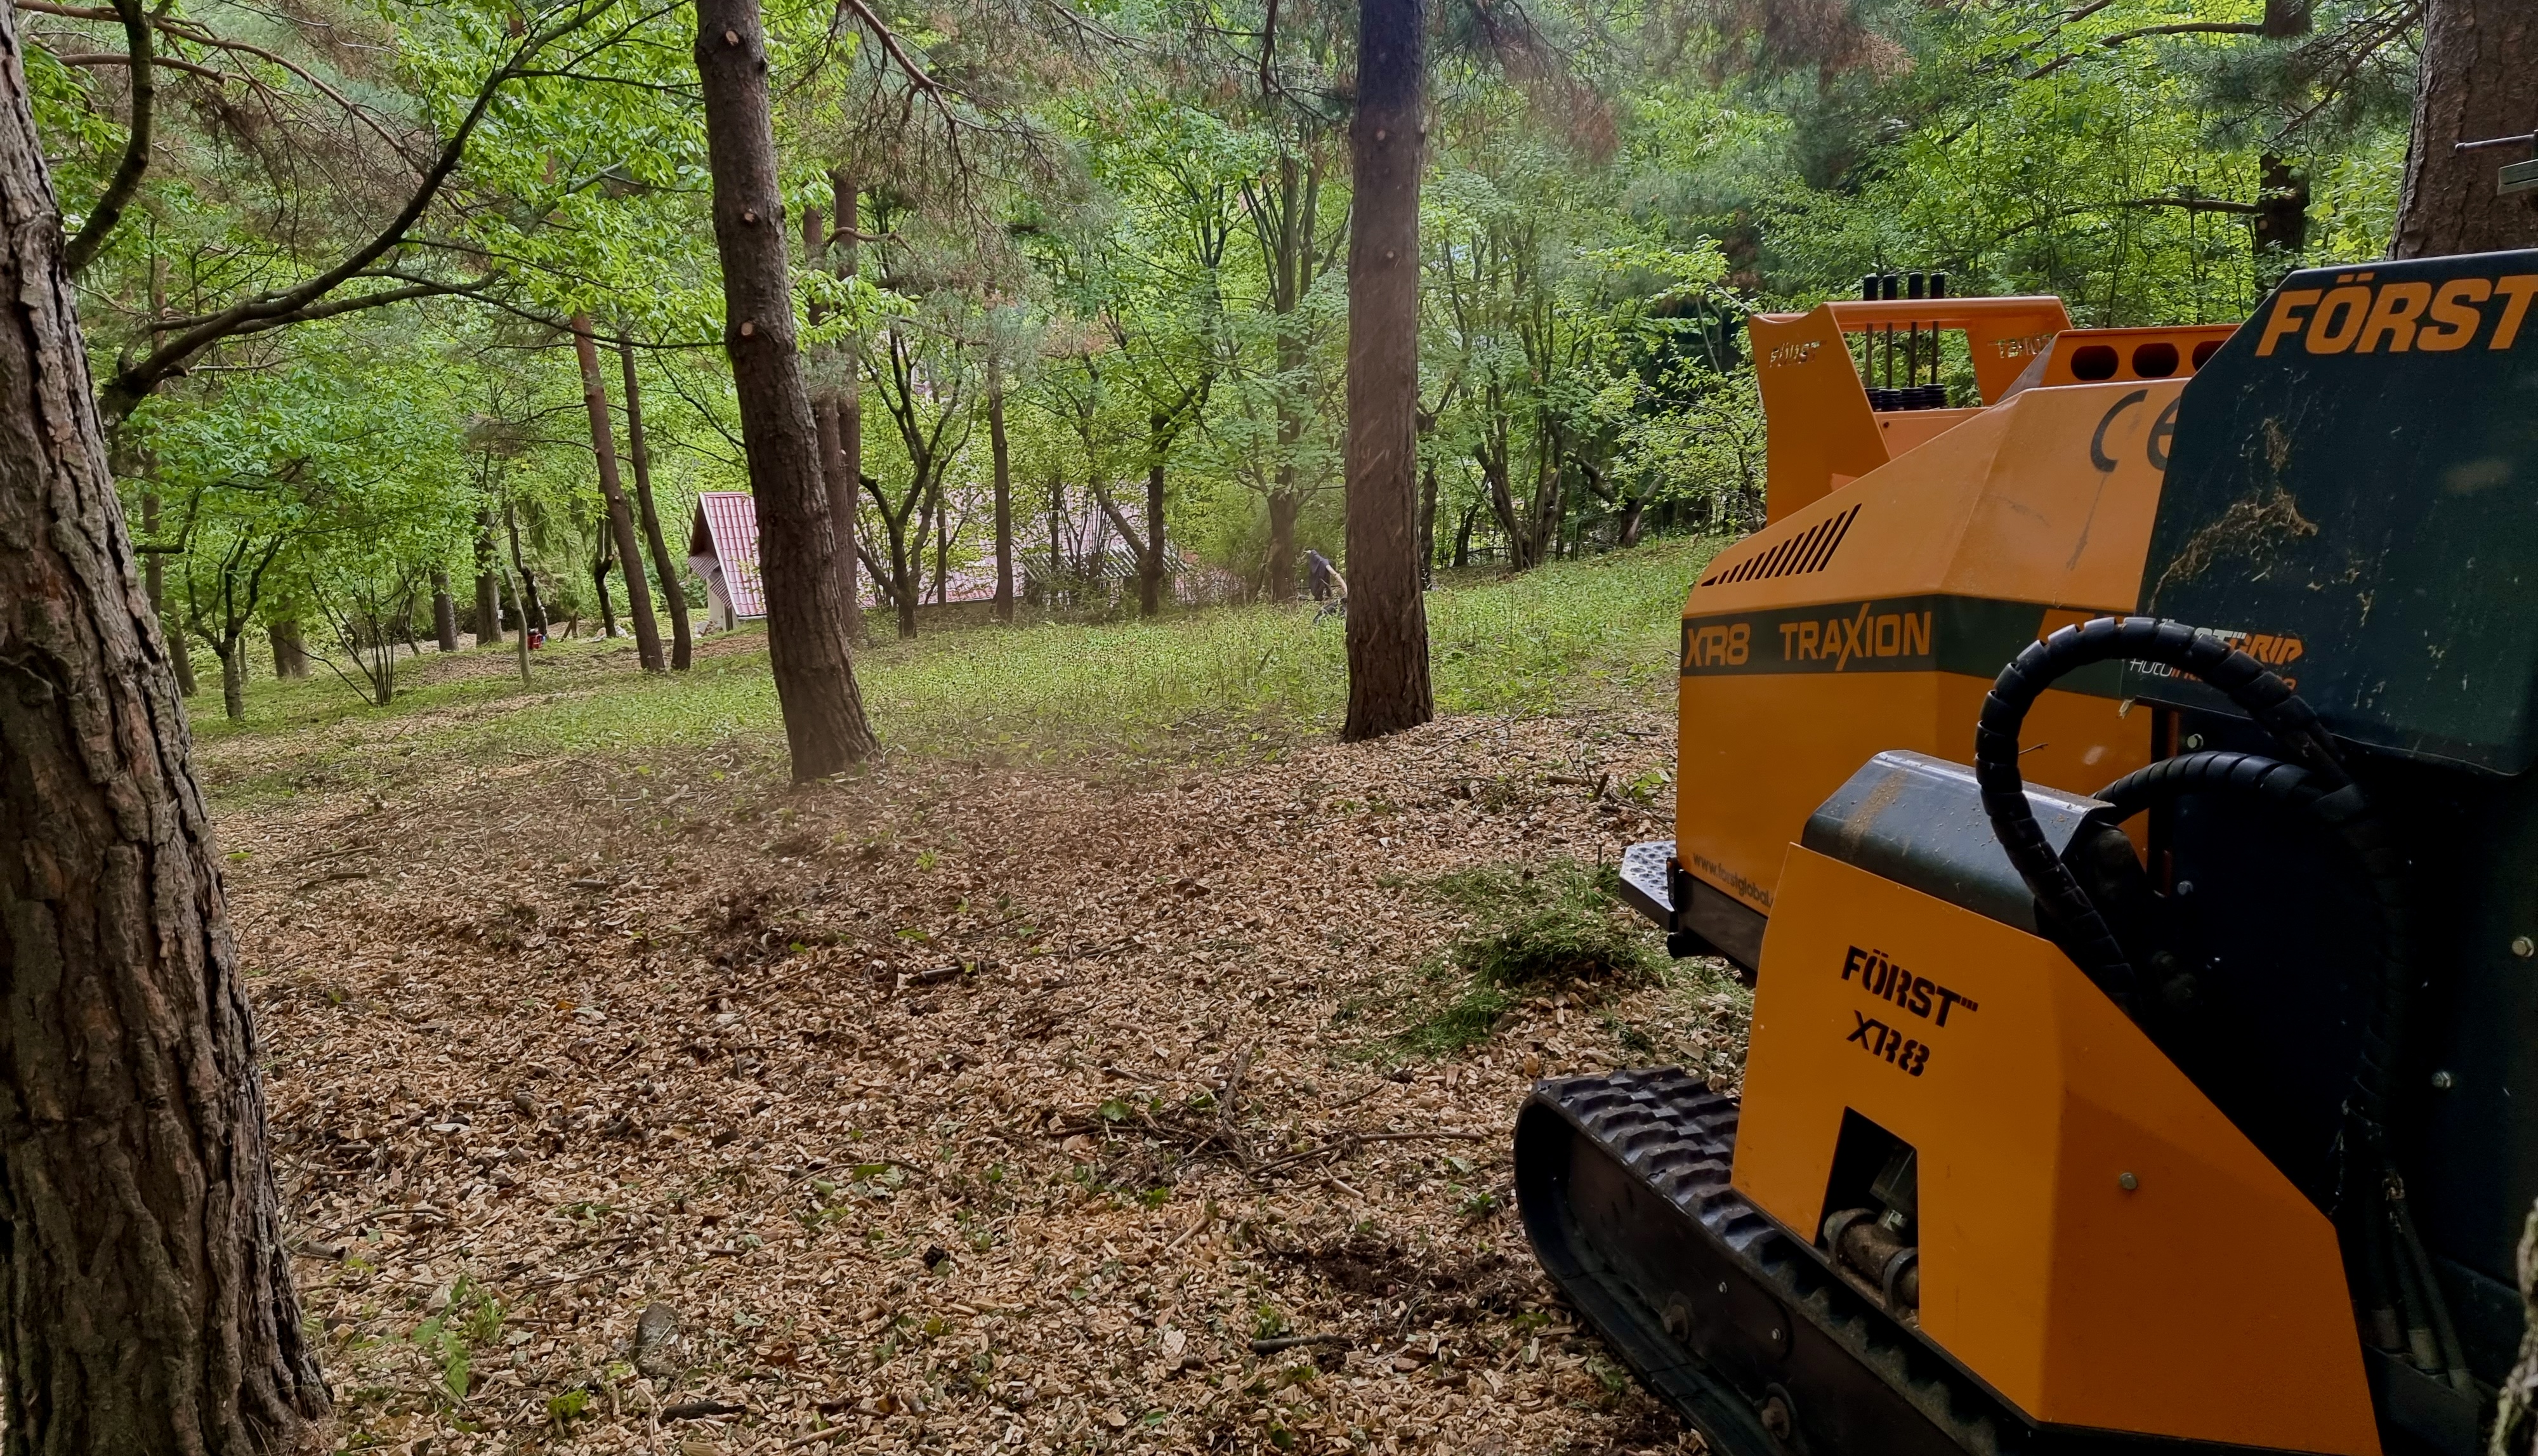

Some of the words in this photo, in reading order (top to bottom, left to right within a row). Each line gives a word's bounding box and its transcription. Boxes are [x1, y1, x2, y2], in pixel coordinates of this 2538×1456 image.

[2255, 272, 2538, 357] FÖRST
[1683, 622, 1751, 668] XR8
[1779, 603, 1932, 672] TRAXION
[1692, 853, 1774, 908] www.forstglobal.
[1846, 1009, 1930, 1077] XR8
